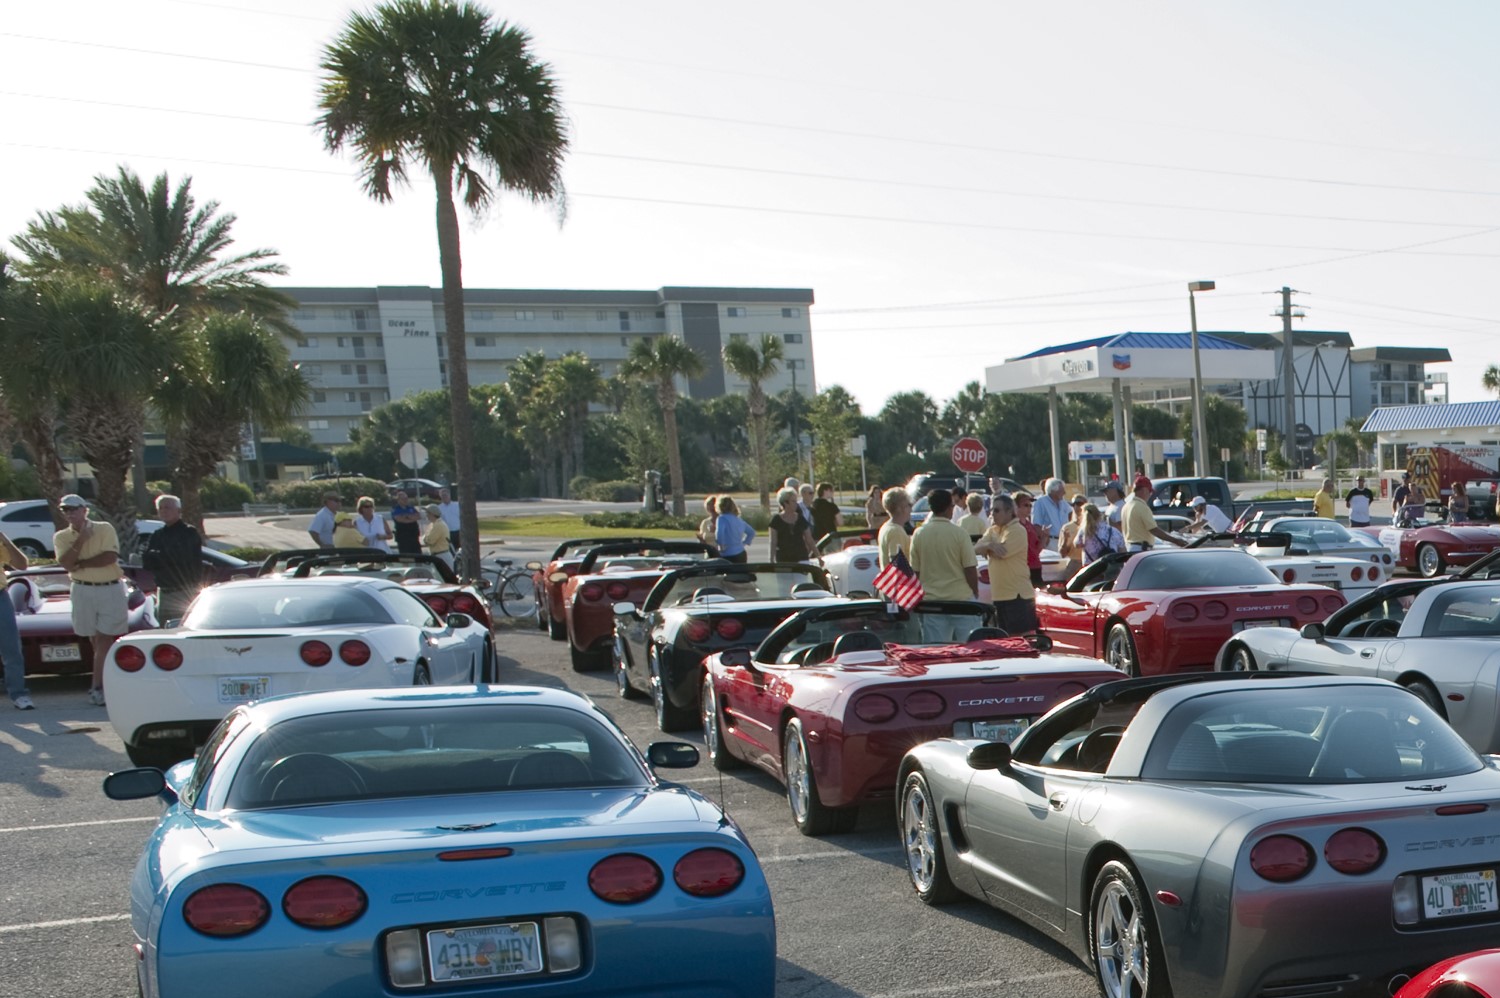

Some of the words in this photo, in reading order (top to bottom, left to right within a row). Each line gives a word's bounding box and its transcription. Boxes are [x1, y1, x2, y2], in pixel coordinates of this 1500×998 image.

[388, 320, 416, 328] Ocean
[954, 447, 985, 463] STOP
[1235, 604, 1290, 613] CORVETTE
[958, 695, 1045, 707] CORVETTE
[391, 880, 567, 904] CORVETTE
[1427, 887, 1445, 909] 4U
[438, 943, 475, 970] 431
[498, 937, 534, 963] WBY
